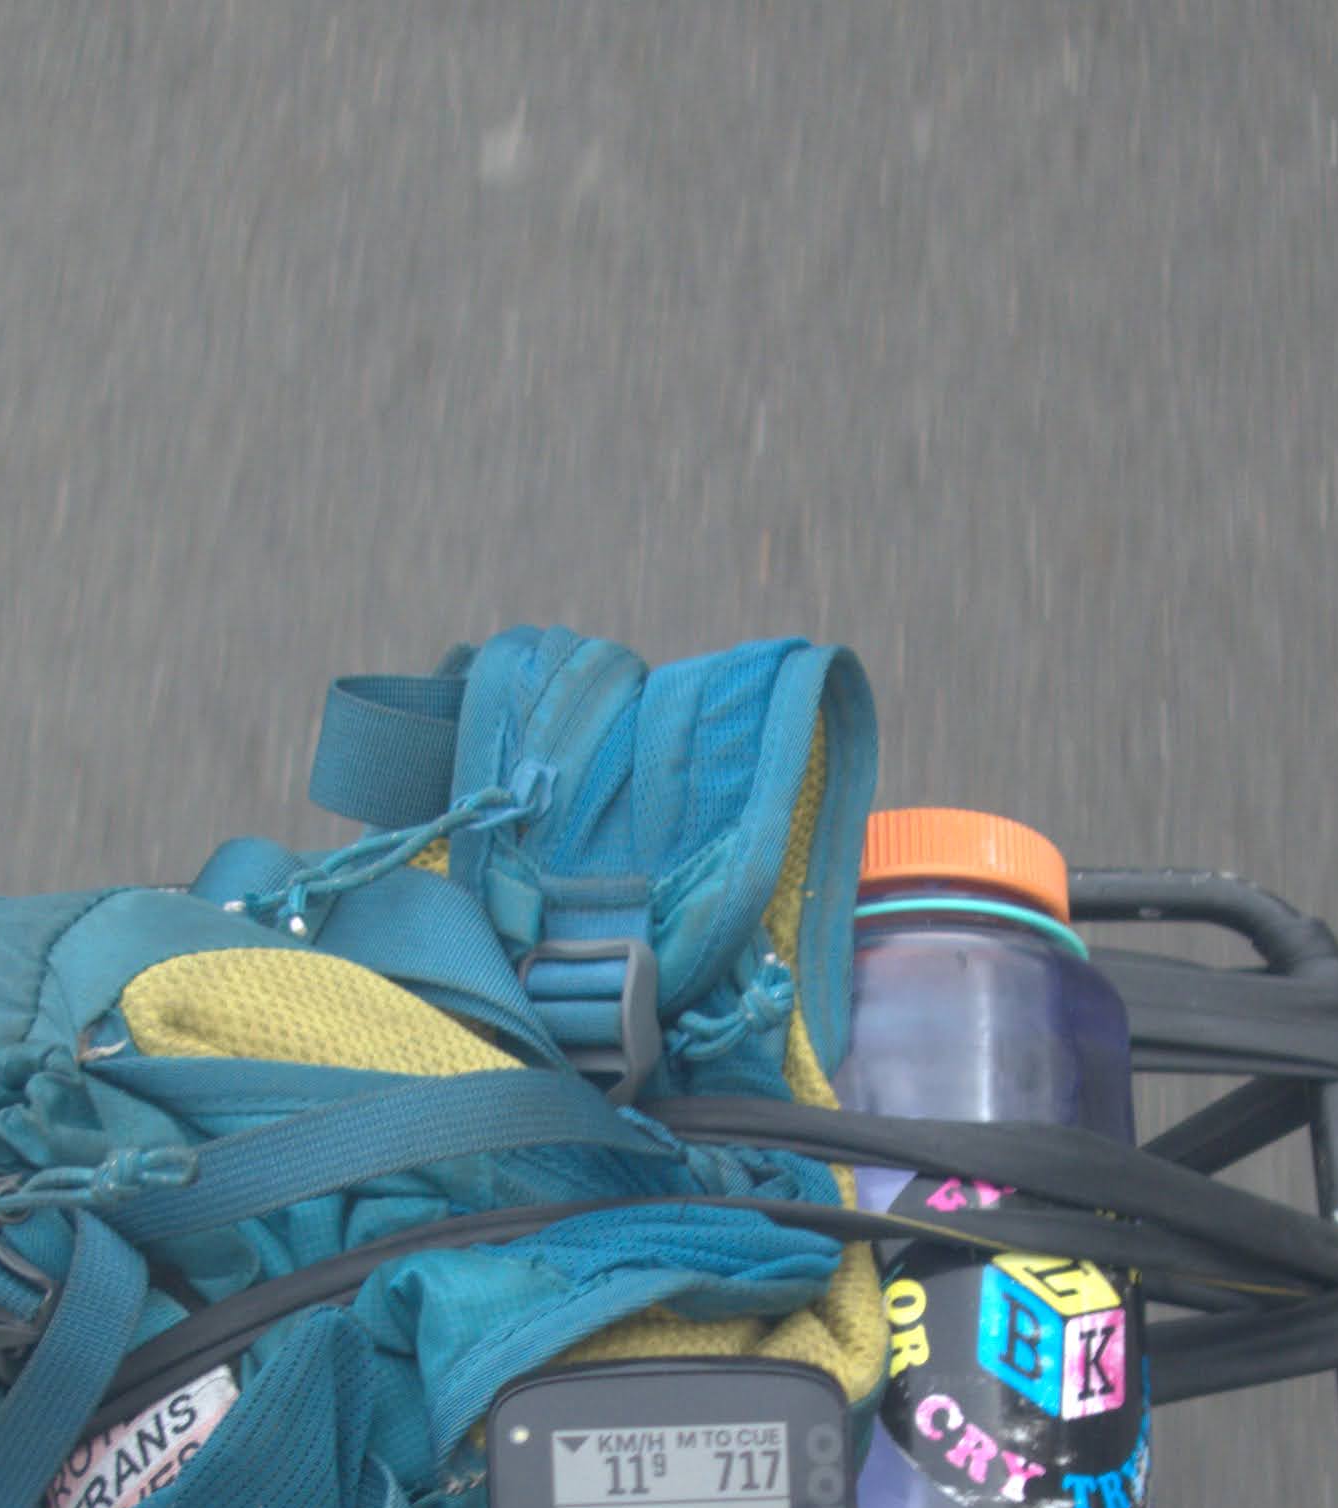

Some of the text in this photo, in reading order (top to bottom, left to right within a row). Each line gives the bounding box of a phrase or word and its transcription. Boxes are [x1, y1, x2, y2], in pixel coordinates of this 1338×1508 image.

[598, 1427, 781, 1453] KM/H M TO CUE
[914, 1394, 1047, 1502] CRY
[713, 1449, 781, 1492] 717
